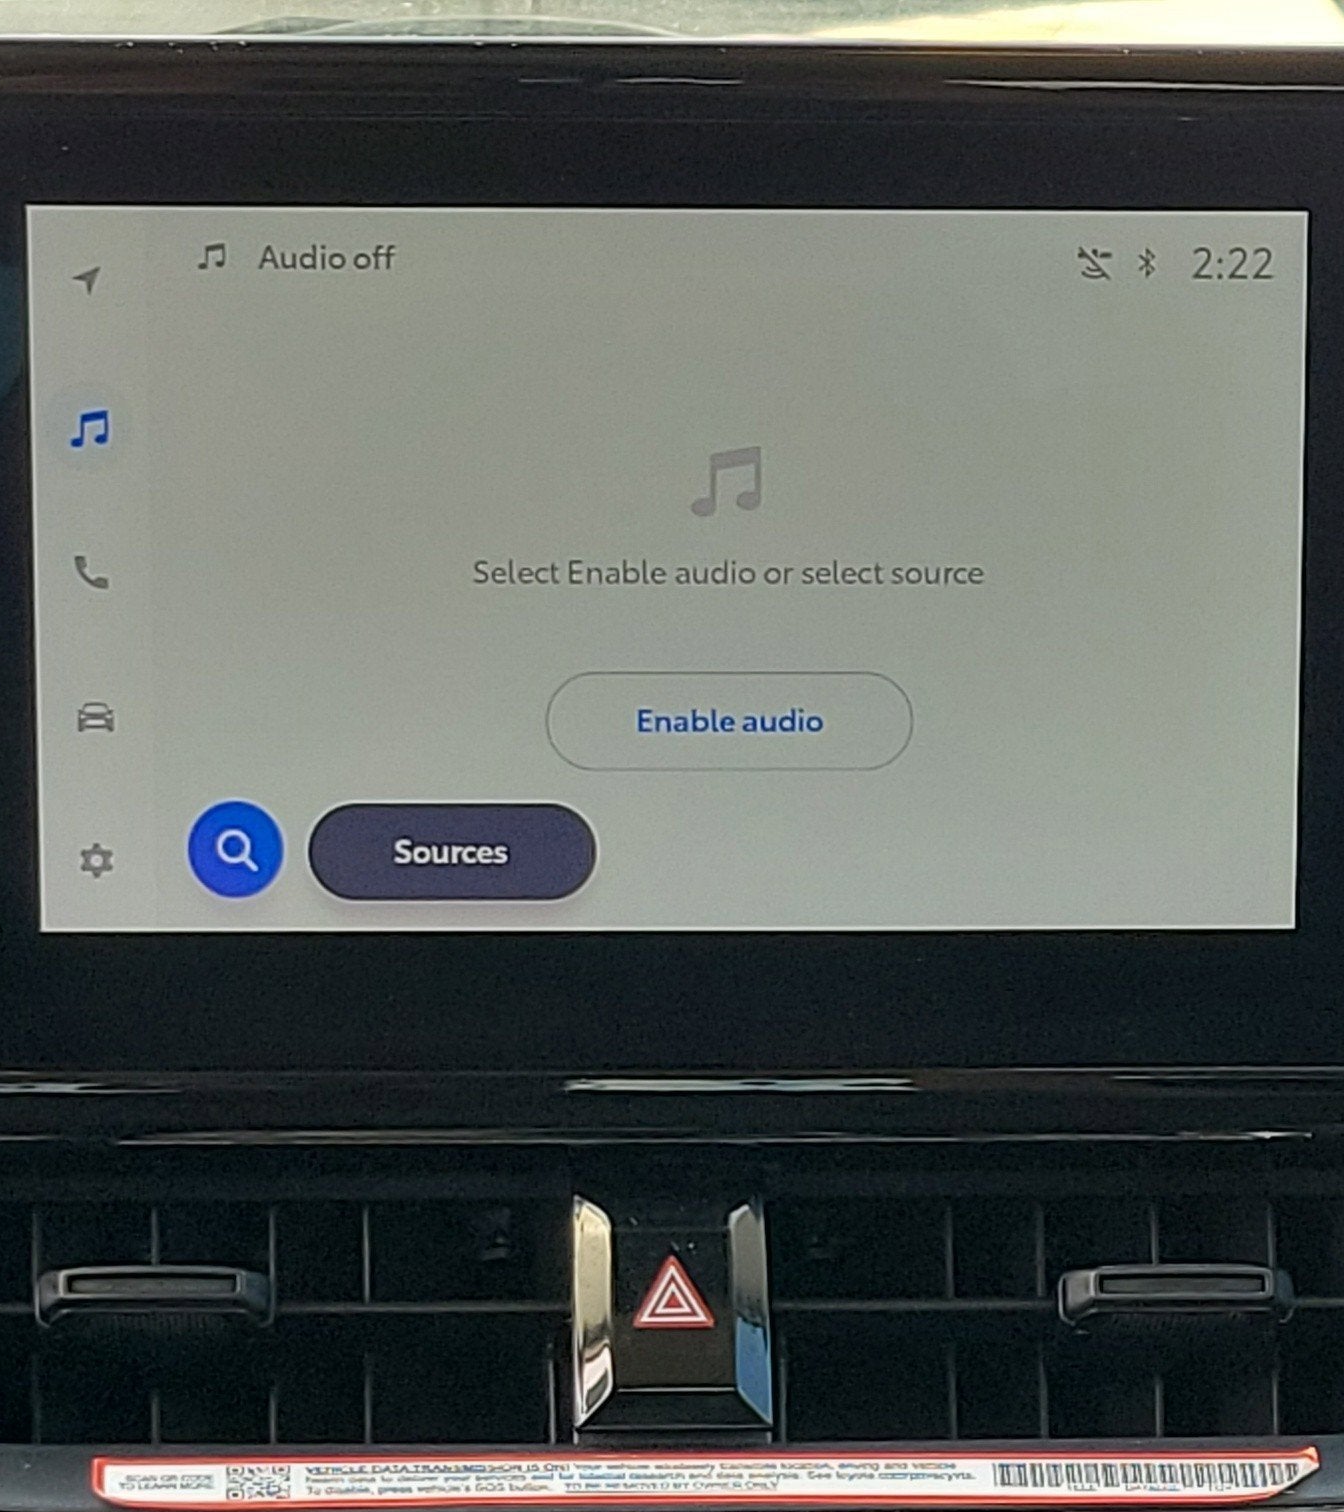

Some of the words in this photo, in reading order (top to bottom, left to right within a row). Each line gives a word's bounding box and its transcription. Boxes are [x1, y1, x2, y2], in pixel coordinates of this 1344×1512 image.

[258, 243, 344, 270] Audio
[353, 243, 397, 270] off
[1192, 246, 1274, 280] 2:22
[473, 558, 560, 585] Select
[568, 558, 667, 585] Enable
[675, 558, 756, 585] audio
[763, 566, 795, 585] or
[801, 558, 884, 585] select
[891, 566, 984, 585] source
[637, 707, 736, 733] Enable
[742, 707, 824, 733] audio
[394, 838, 508, 864] Sources
